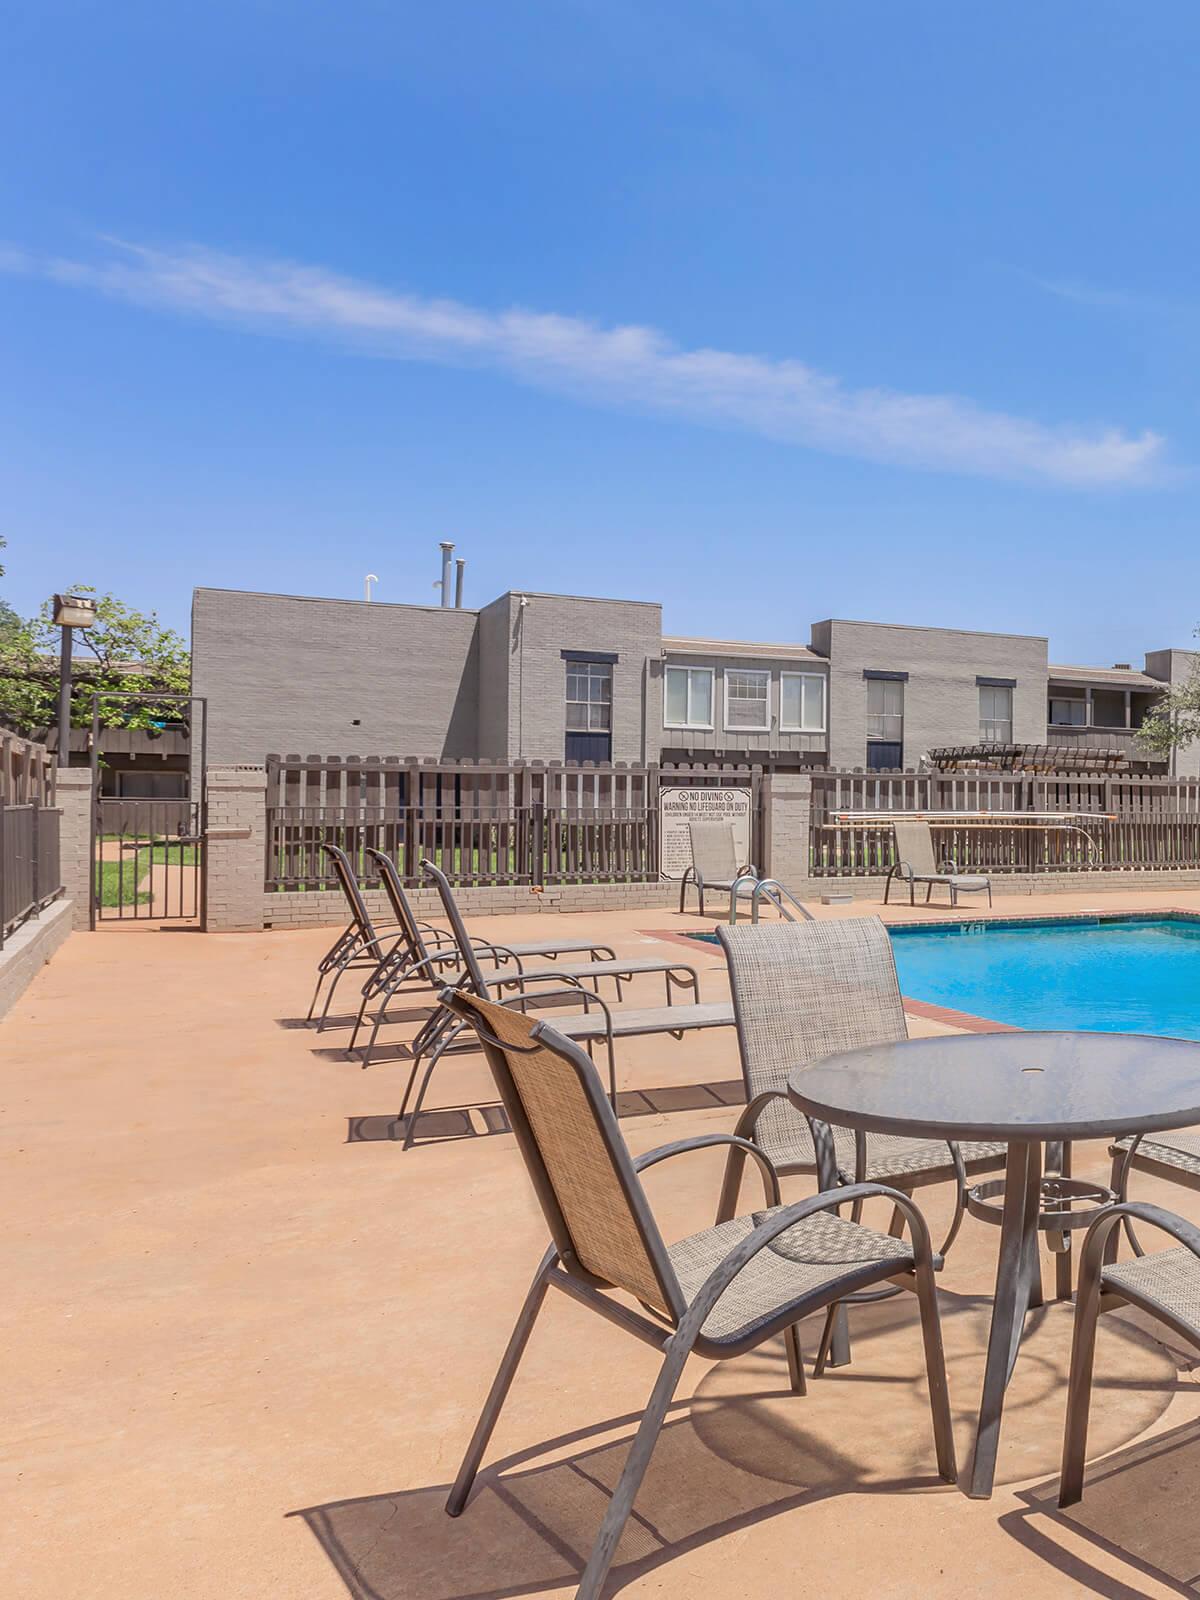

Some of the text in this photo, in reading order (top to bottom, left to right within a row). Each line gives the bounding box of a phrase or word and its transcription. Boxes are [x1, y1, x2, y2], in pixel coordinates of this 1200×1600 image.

[690, 792, 723, 801] NO DIVING
[664, 802, 748, 811] WARNING NO LIFEGUARD ON DUTY
